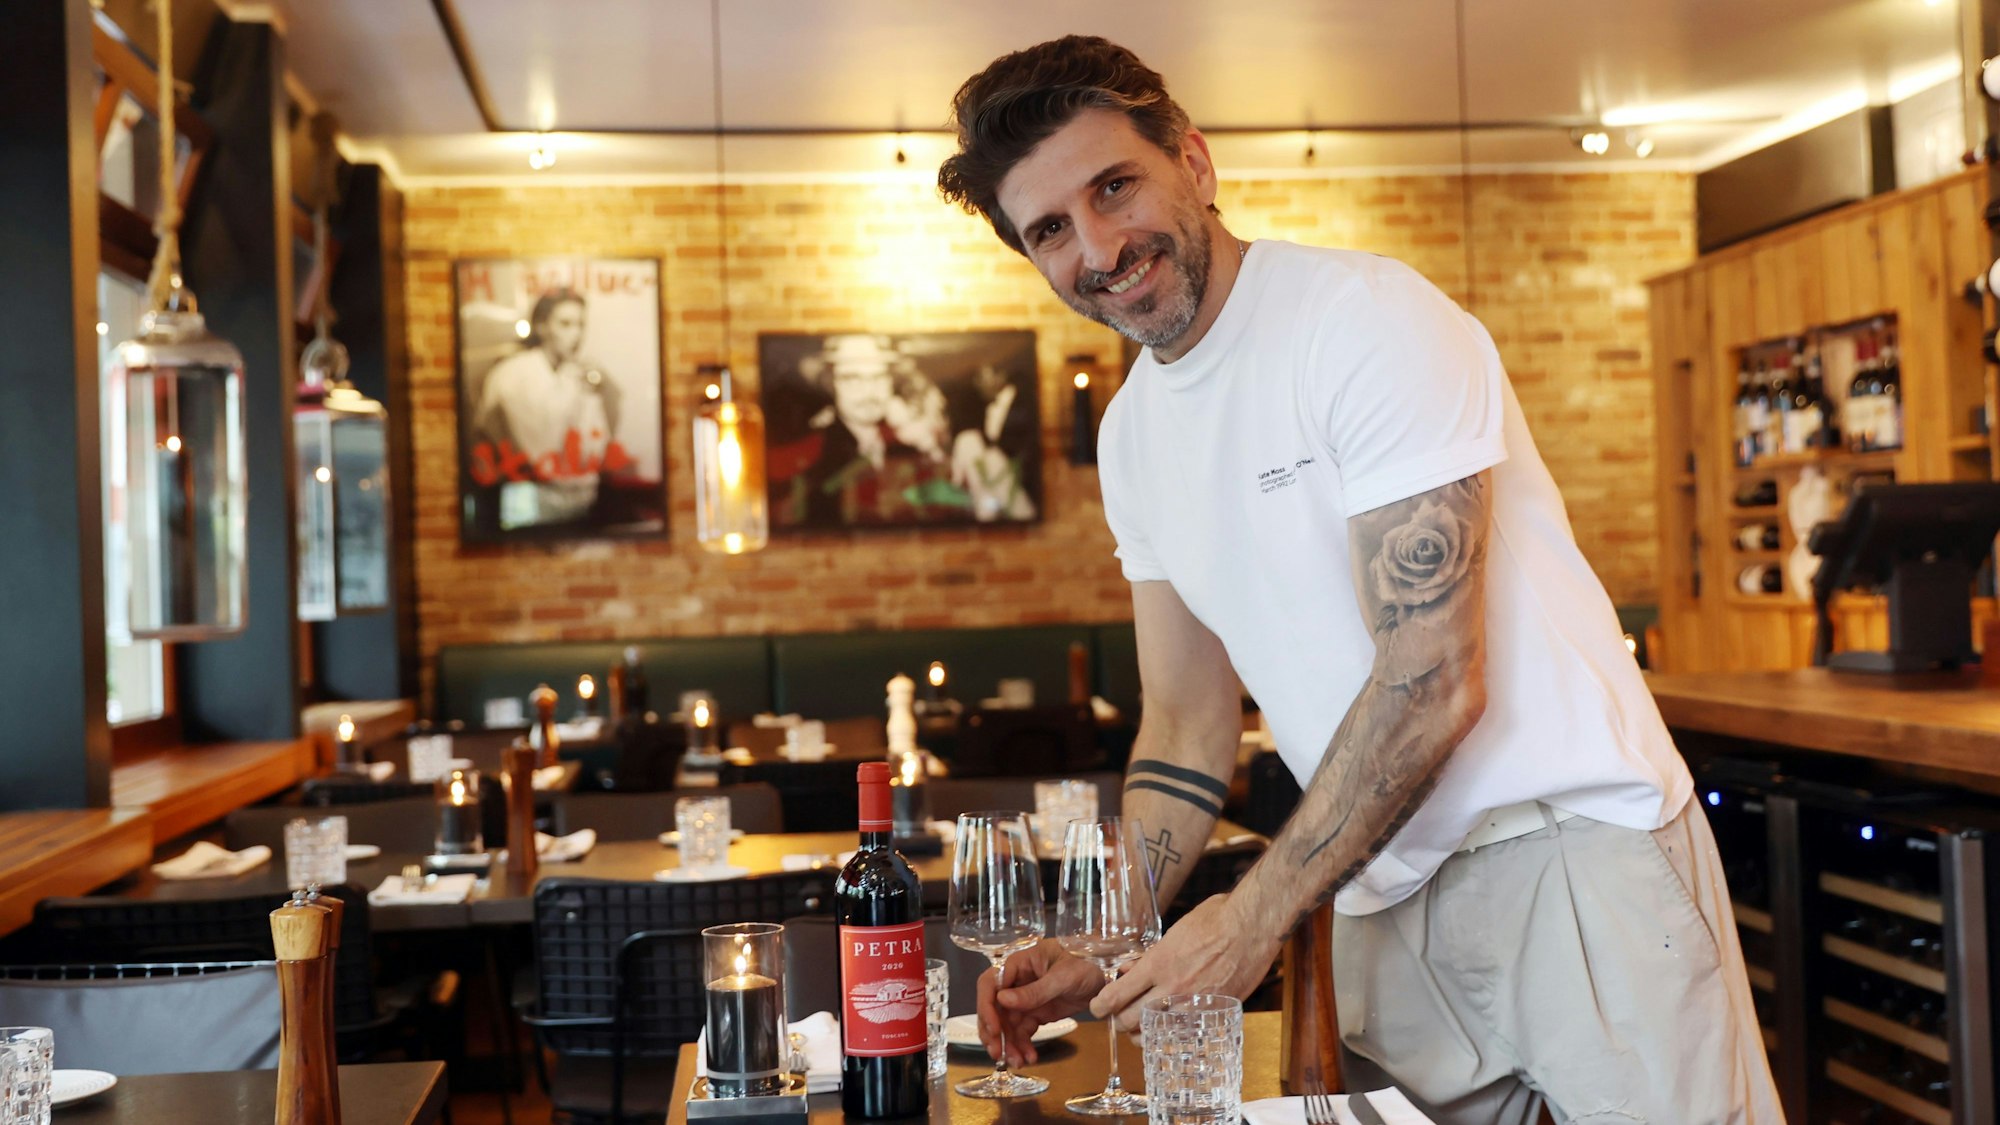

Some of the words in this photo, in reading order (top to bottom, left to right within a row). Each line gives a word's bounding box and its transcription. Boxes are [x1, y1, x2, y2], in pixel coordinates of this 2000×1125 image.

[1271, 467, 1286, 475] Moss
[853, 937, 922, 957] PETRA
[881, 962, 904, 971] 2020
